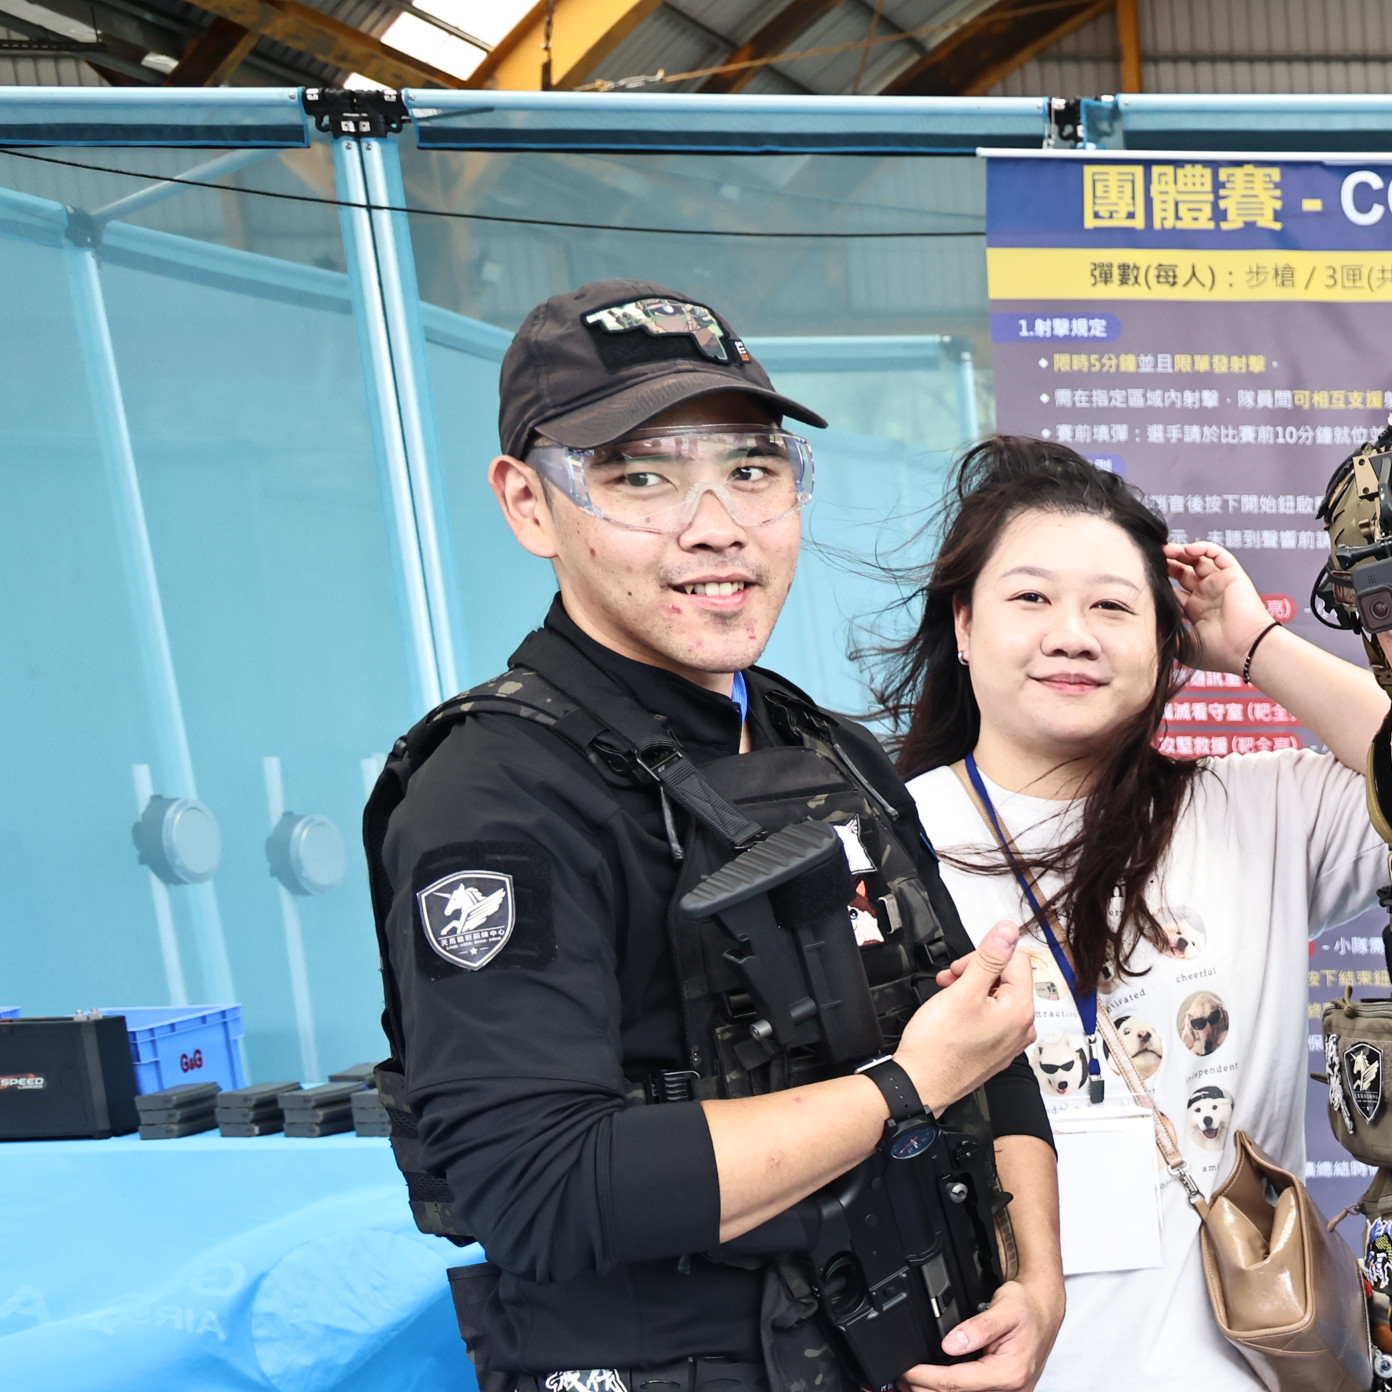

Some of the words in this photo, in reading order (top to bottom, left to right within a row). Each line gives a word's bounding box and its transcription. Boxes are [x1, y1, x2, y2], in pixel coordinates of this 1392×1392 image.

[1083, 164, 1284, 232] 團體賽
[1018, 317, 1108, 339] 1.射擊規定
[1176, 967, 1217, 983] cheerful
[1035, 1009, 1077, 1019] ttractive
[180, 1048, 204, 1074] G&G
